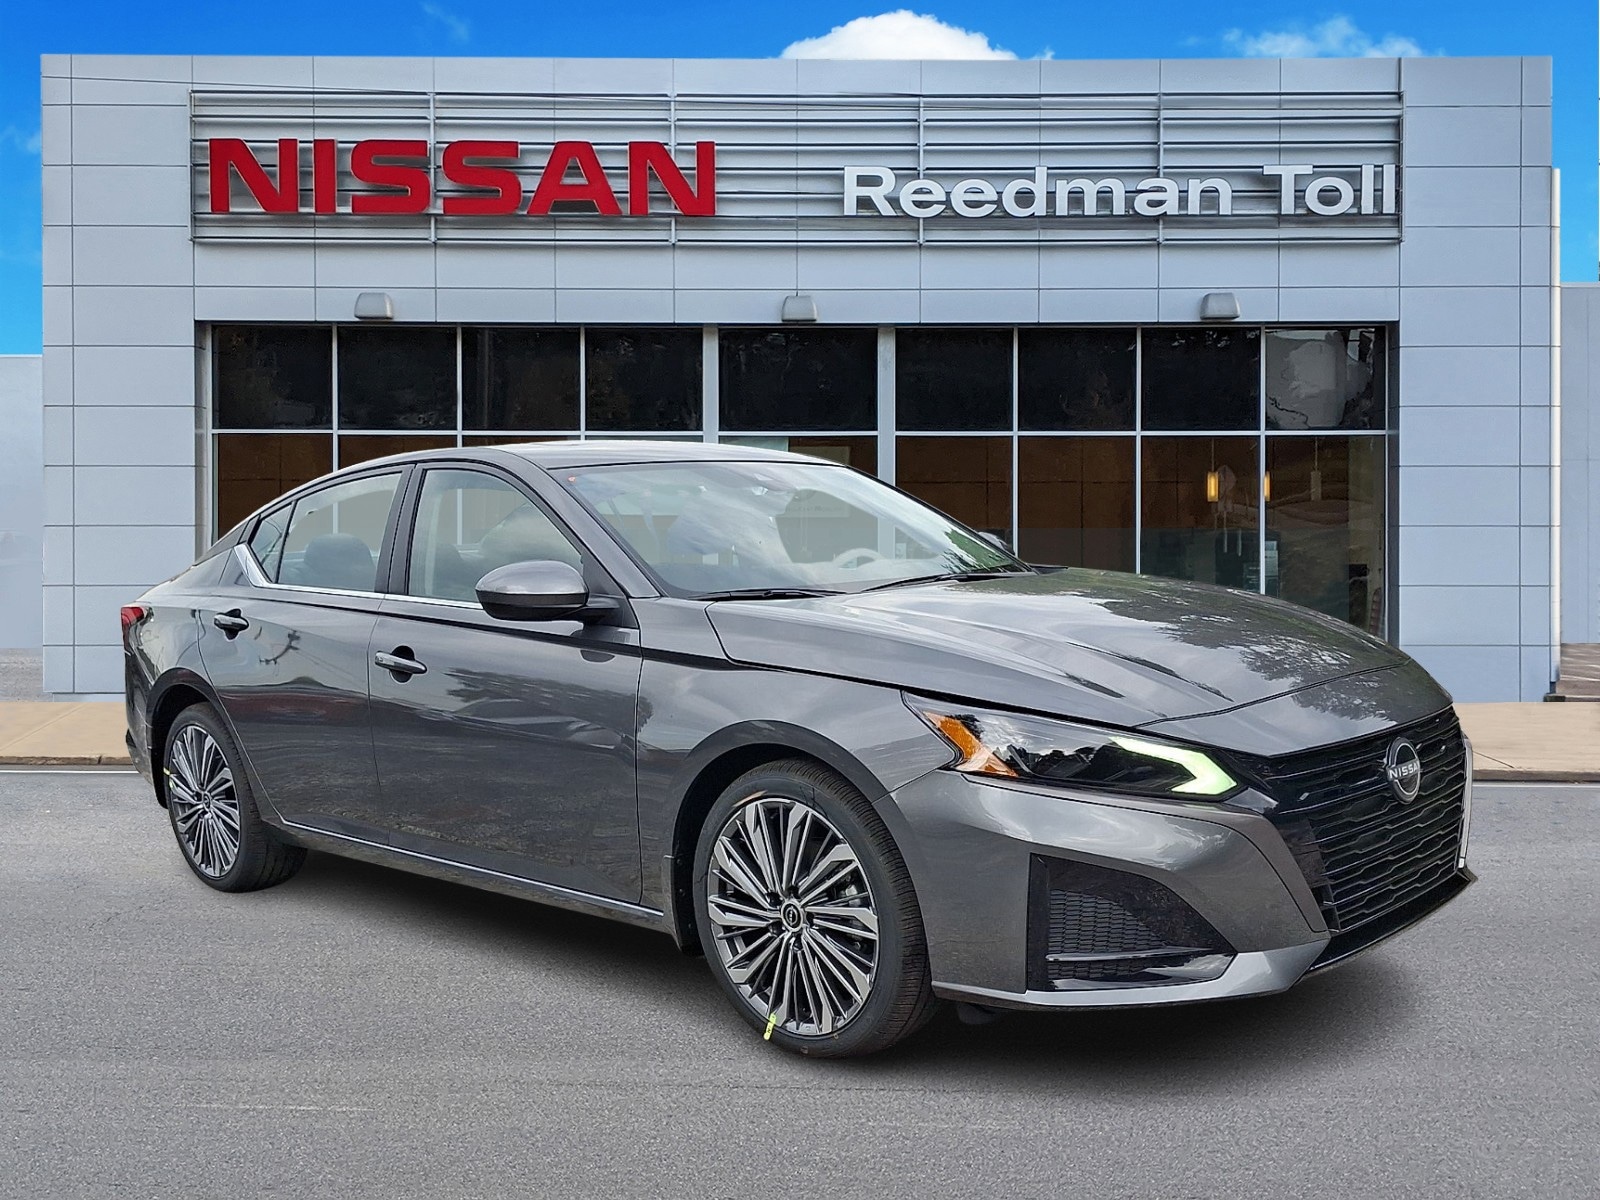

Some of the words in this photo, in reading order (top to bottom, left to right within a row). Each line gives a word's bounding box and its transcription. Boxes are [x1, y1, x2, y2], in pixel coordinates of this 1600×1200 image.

[208, 138, 716, 216] NISSAN
[843, 165, 1232, 218] Reedman
[1262, 164, 1396, 216] Toll
